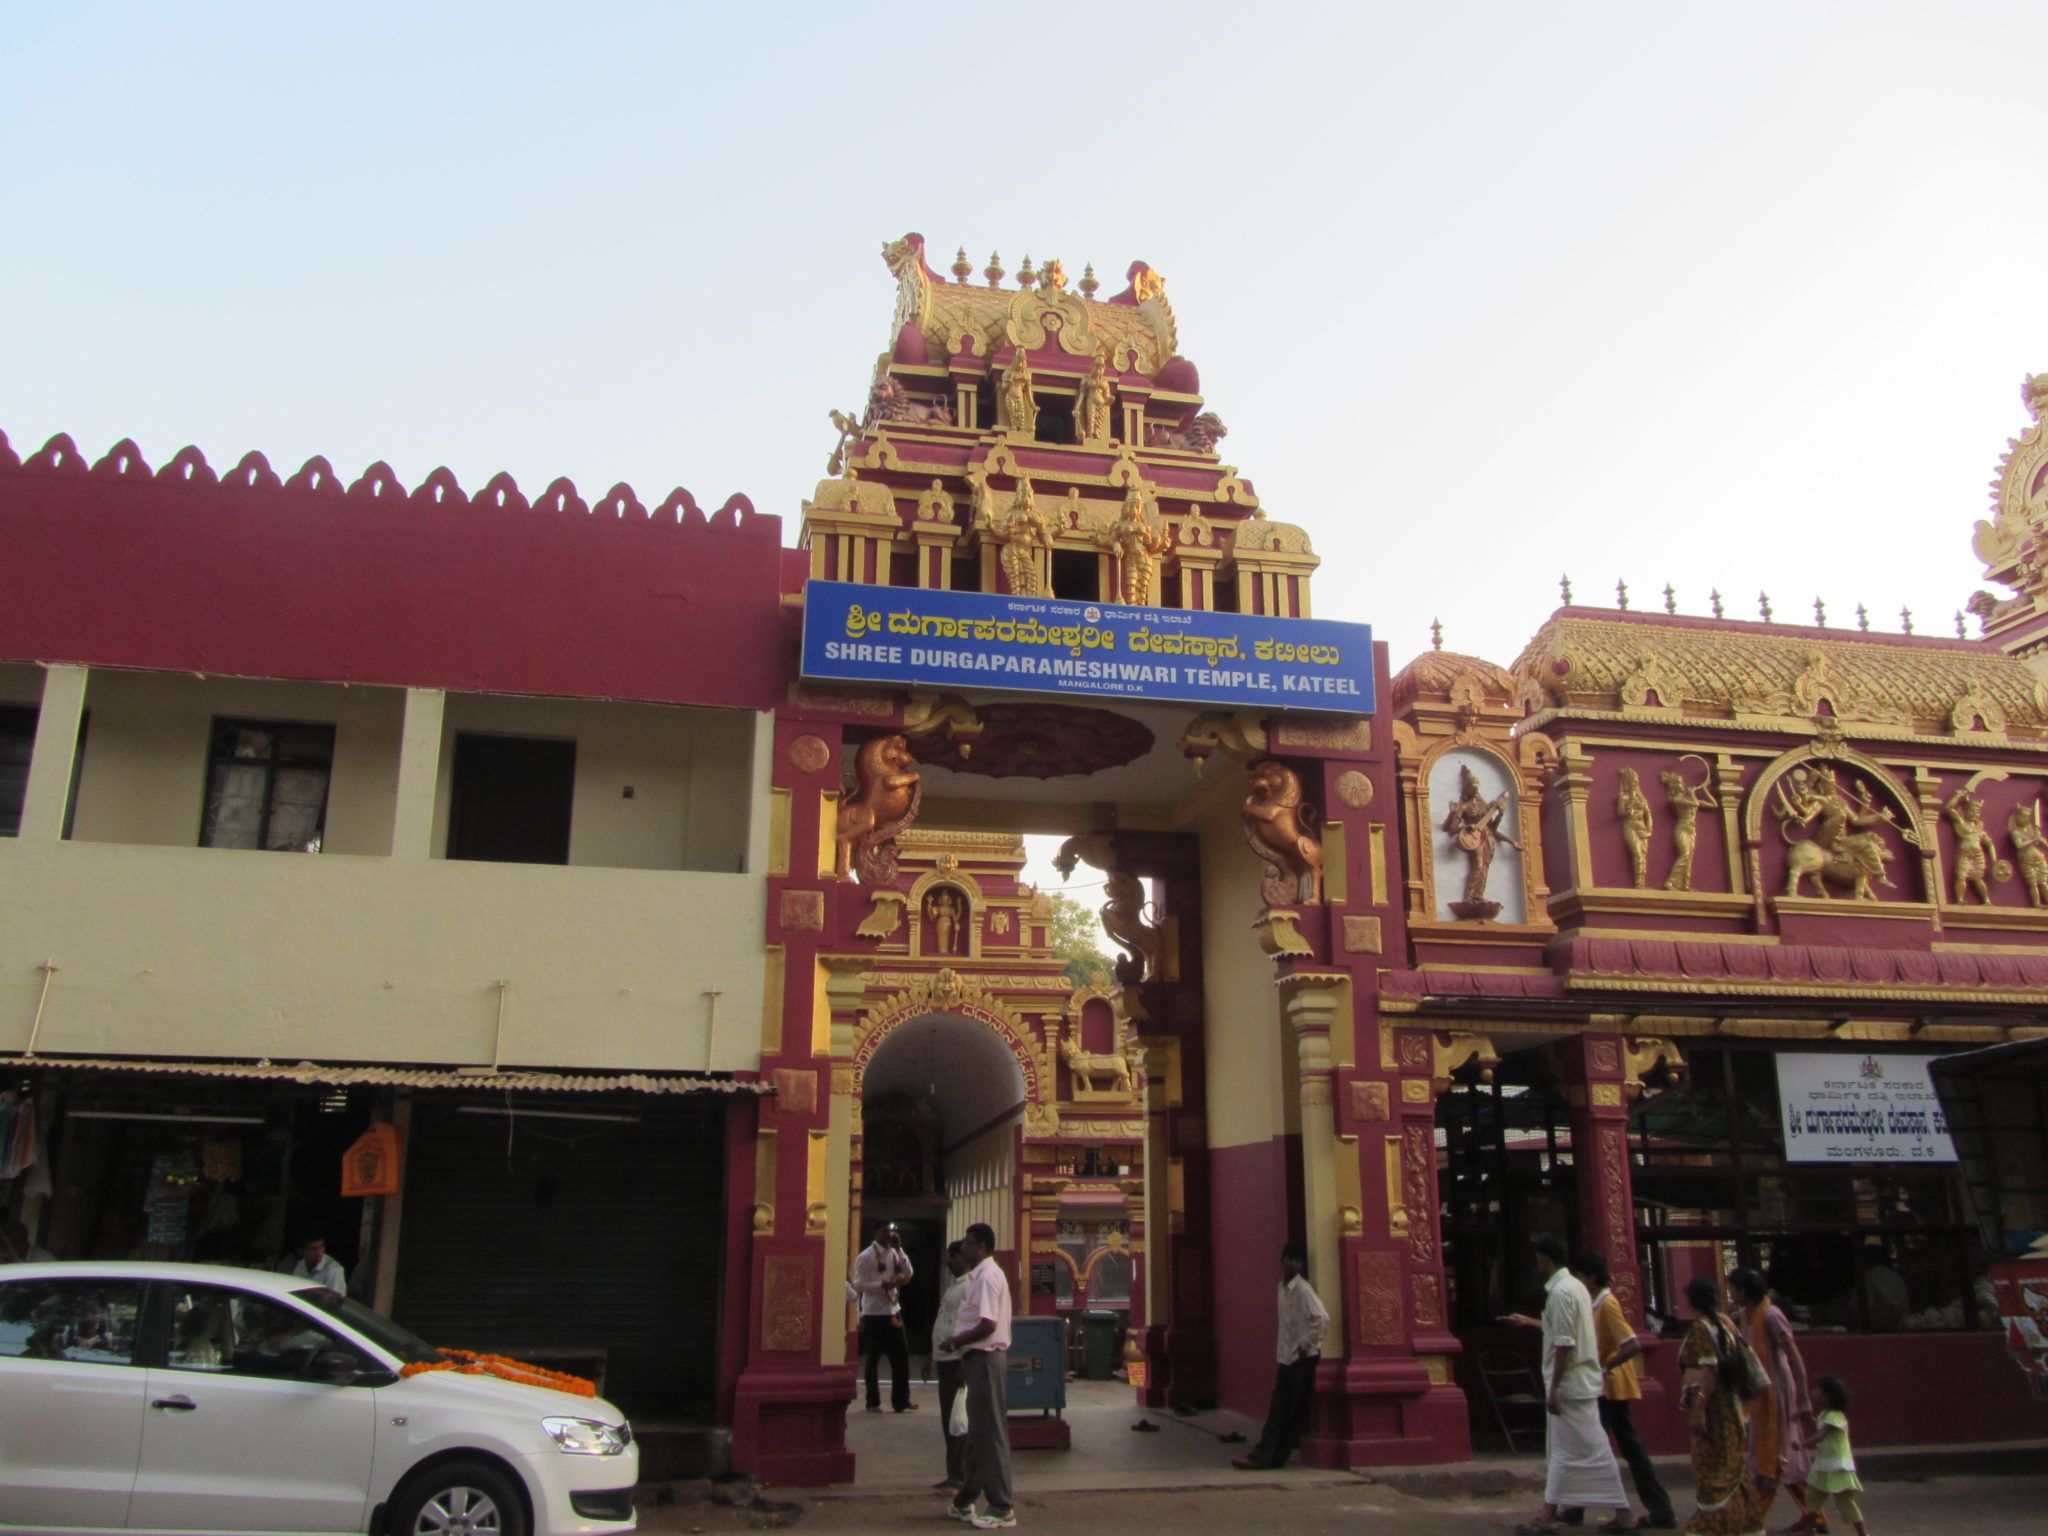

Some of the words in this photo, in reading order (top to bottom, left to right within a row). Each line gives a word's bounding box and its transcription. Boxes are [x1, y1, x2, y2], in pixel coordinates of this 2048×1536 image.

[1008, 602, 1046, 613] ಕರ್ನಾಟಕ
[1050, 605, 1081, 616] ಸರಕಾರ
[846, 604, 882, 638] ಶ್ರೀ
[1128, 626, 1246, 667] ದೇವಸ್ಥಾನ,
[1254, 636, 1340, 666] ಕಟೀಲು
[825, 641, 902, 664] SHREE
[911, 648, 1177, 684] DURGAPARAMESHWARI
[1184, 668, 1278, 693] TEMPLE,
[1283, 675, 1361, 695] KATEEL
[1058, 680, 1124, 691] MANGALORE
